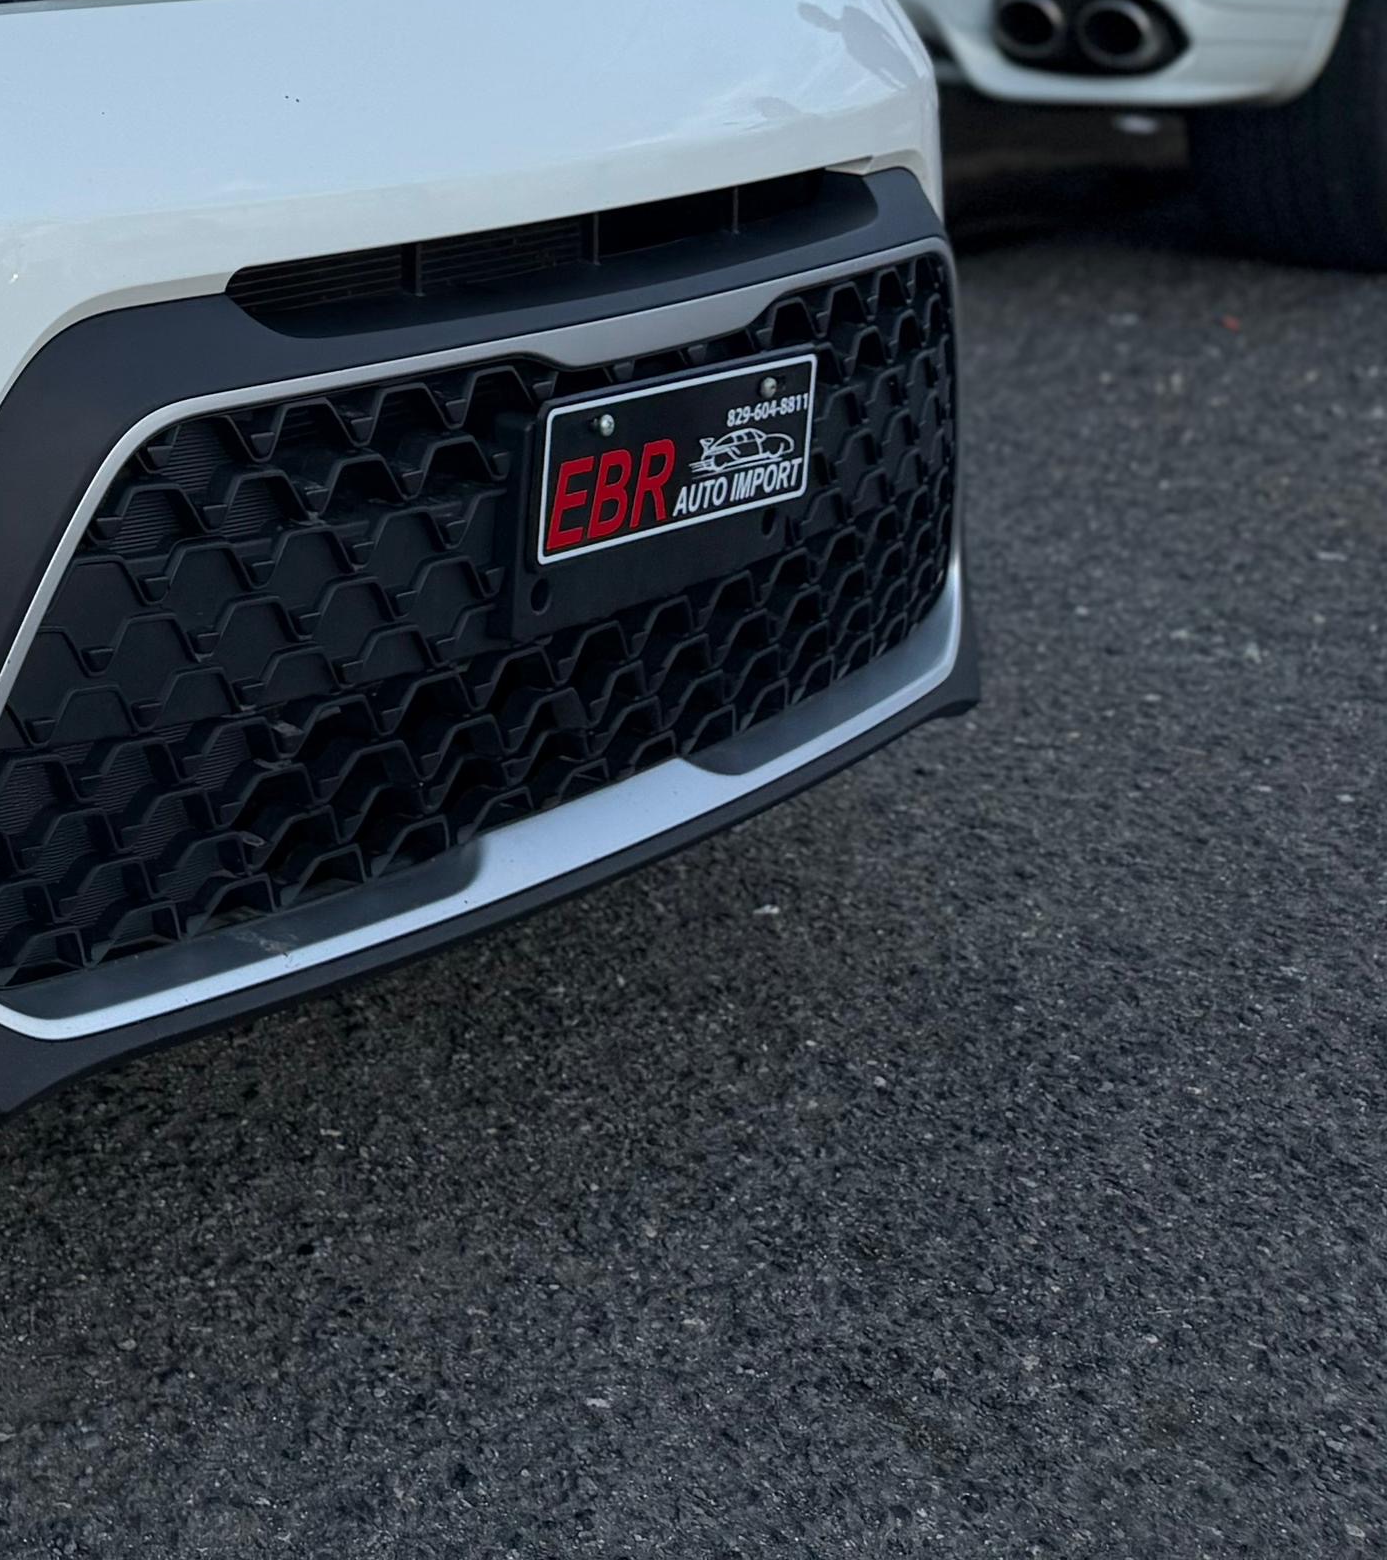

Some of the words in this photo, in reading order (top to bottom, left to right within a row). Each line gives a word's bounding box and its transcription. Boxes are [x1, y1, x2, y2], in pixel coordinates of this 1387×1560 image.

[727, 392, 809, 428] 829-604-8811
[546, 438, 676, 551] EBR
[673, 477, 729, 517] AUTO
[730, 458, 803, 503] IMPORT
